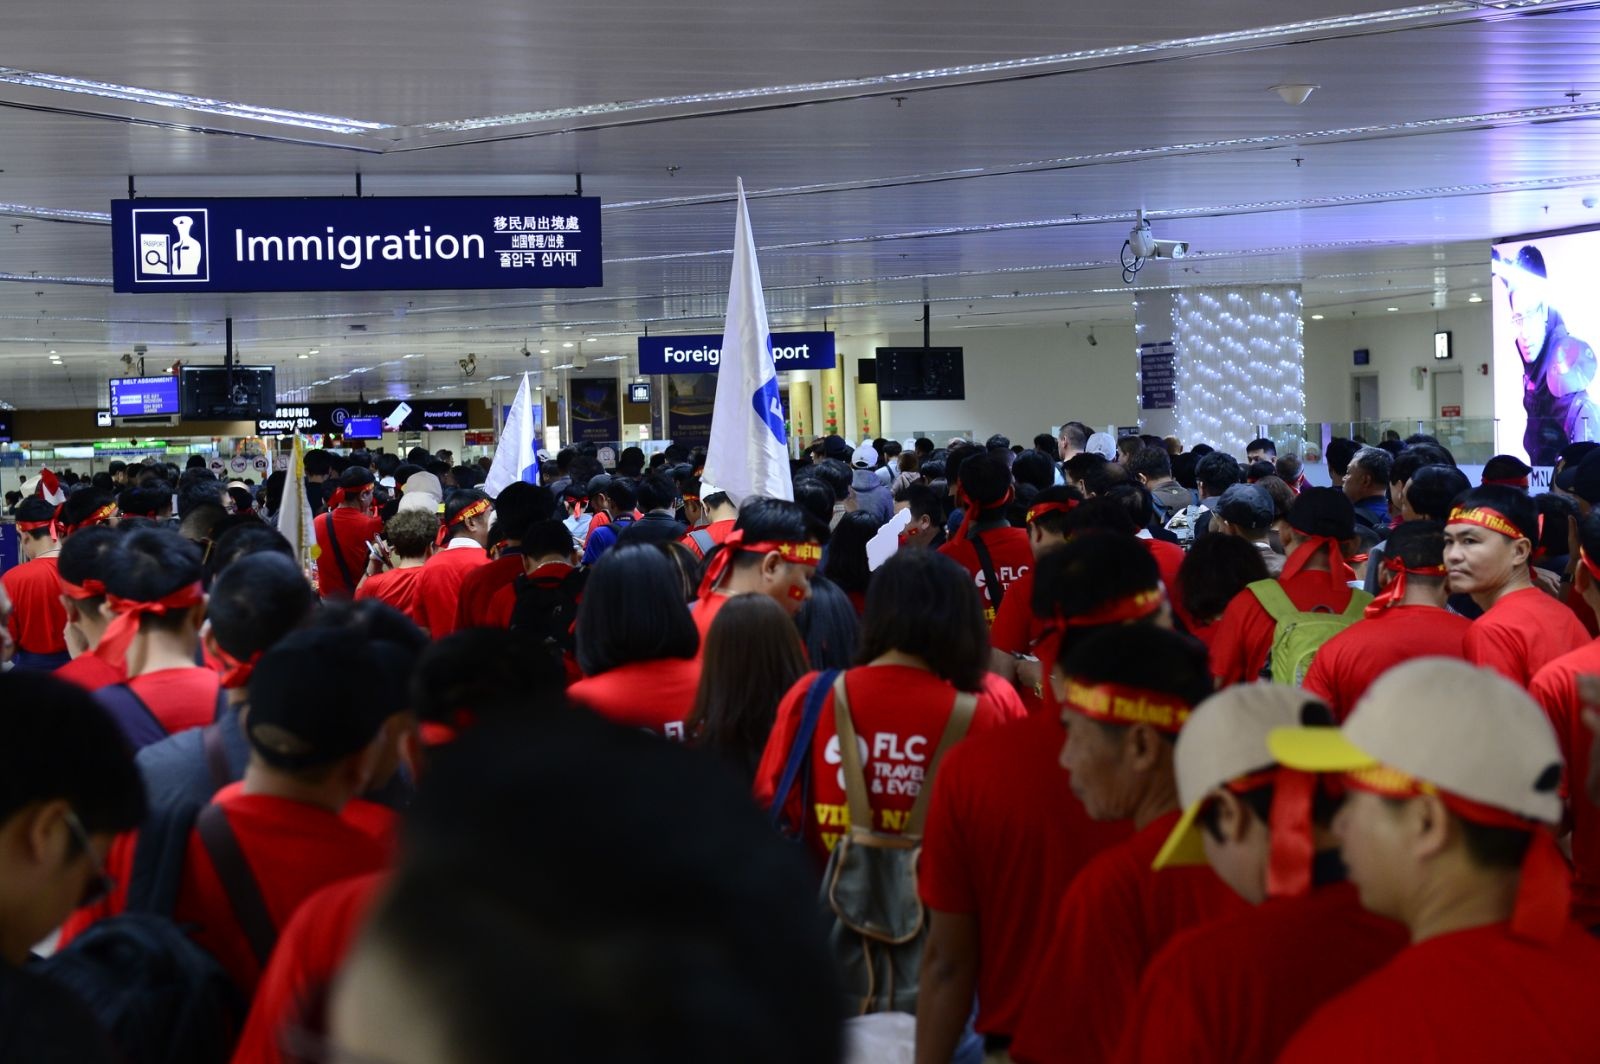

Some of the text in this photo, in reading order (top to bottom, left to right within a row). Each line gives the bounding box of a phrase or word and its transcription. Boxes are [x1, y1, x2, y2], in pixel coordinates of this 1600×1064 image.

[493, 216, 580, 231] 移民局出境處
[235, 226, 485, 270] Immigration
[500, 252, 577, 268] 출입국 심사대
[664, 346, 722, 366] Foreig
[122, 378, 137, 386] BELT
[137, 376, 173, 385] ASSIGNMENT
[111, 386, 116, 396] 1
[111, 396, 118, 406] 2
[112, 406, 118, 416] 3
[259, 417, 318, 432] Galaxy S10+
[344, 422, 353, 435] 4
[872, 731, 928, 763] FLC
[871, 778, 883, 794] &
